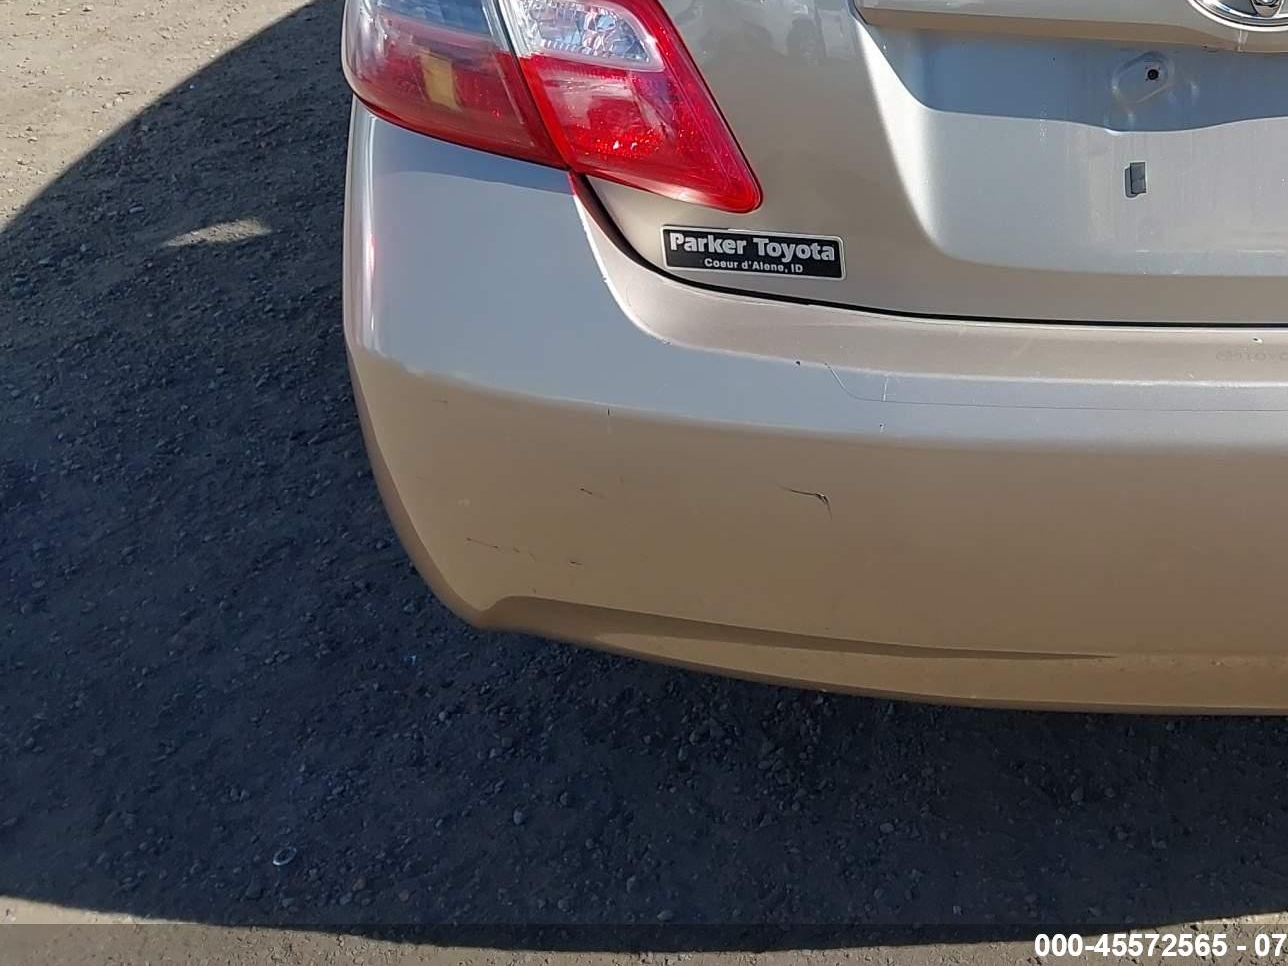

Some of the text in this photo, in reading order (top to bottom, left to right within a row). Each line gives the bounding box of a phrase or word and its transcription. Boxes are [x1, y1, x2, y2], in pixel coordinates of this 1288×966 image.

[669, 232, 836, 263] Parker Toyota
[704, 258, 804, 274] Coeur d'Alene, ID
